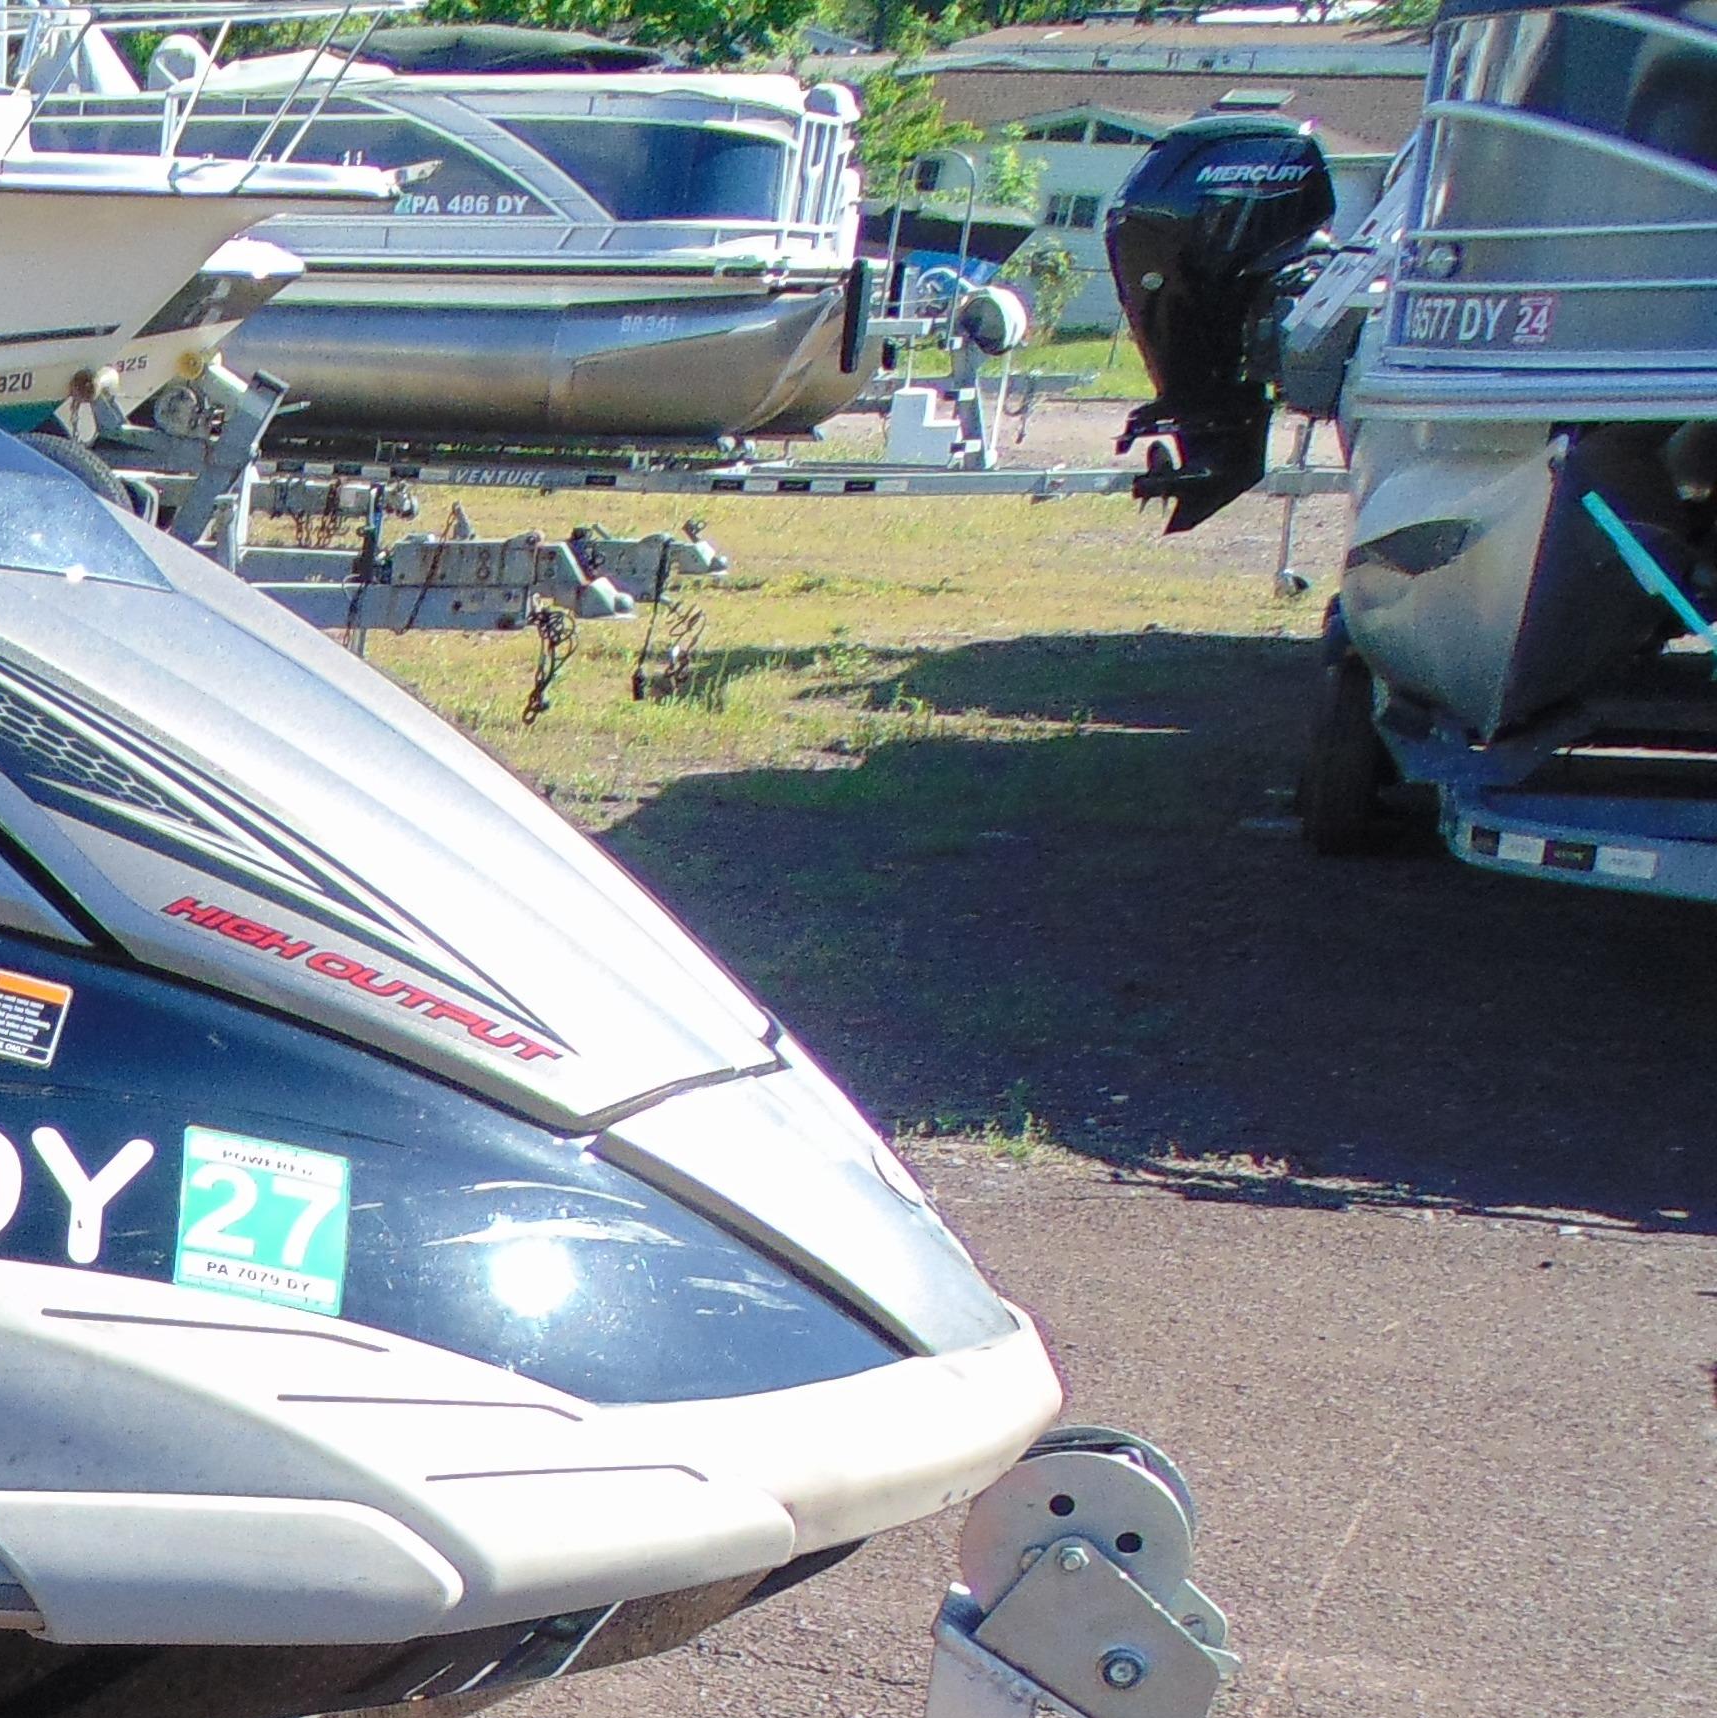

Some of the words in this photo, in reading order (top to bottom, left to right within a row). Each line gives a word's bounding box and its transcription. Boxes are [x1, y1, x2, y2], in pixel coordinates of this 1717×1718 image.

[1196, 164, 1314, 185] MERCURY
[411, 194, 440, 214] PA
[495, 194, 529, 214] DY
[1458, 298, 1509, 341] DY
[1515, 305, 1549, 335] 24
[454, 468, 545, 486] VENTURE
[162, 895, 316, 960] HIGH
[305, 951, 564, 1062] OUTPUT
[182, 1160, 343, 1267] 27
[206, 1261, 229, 1276] PA
[237, 1267, 280, 1286] 7079
[287, 1278, 312, 1293] DY
